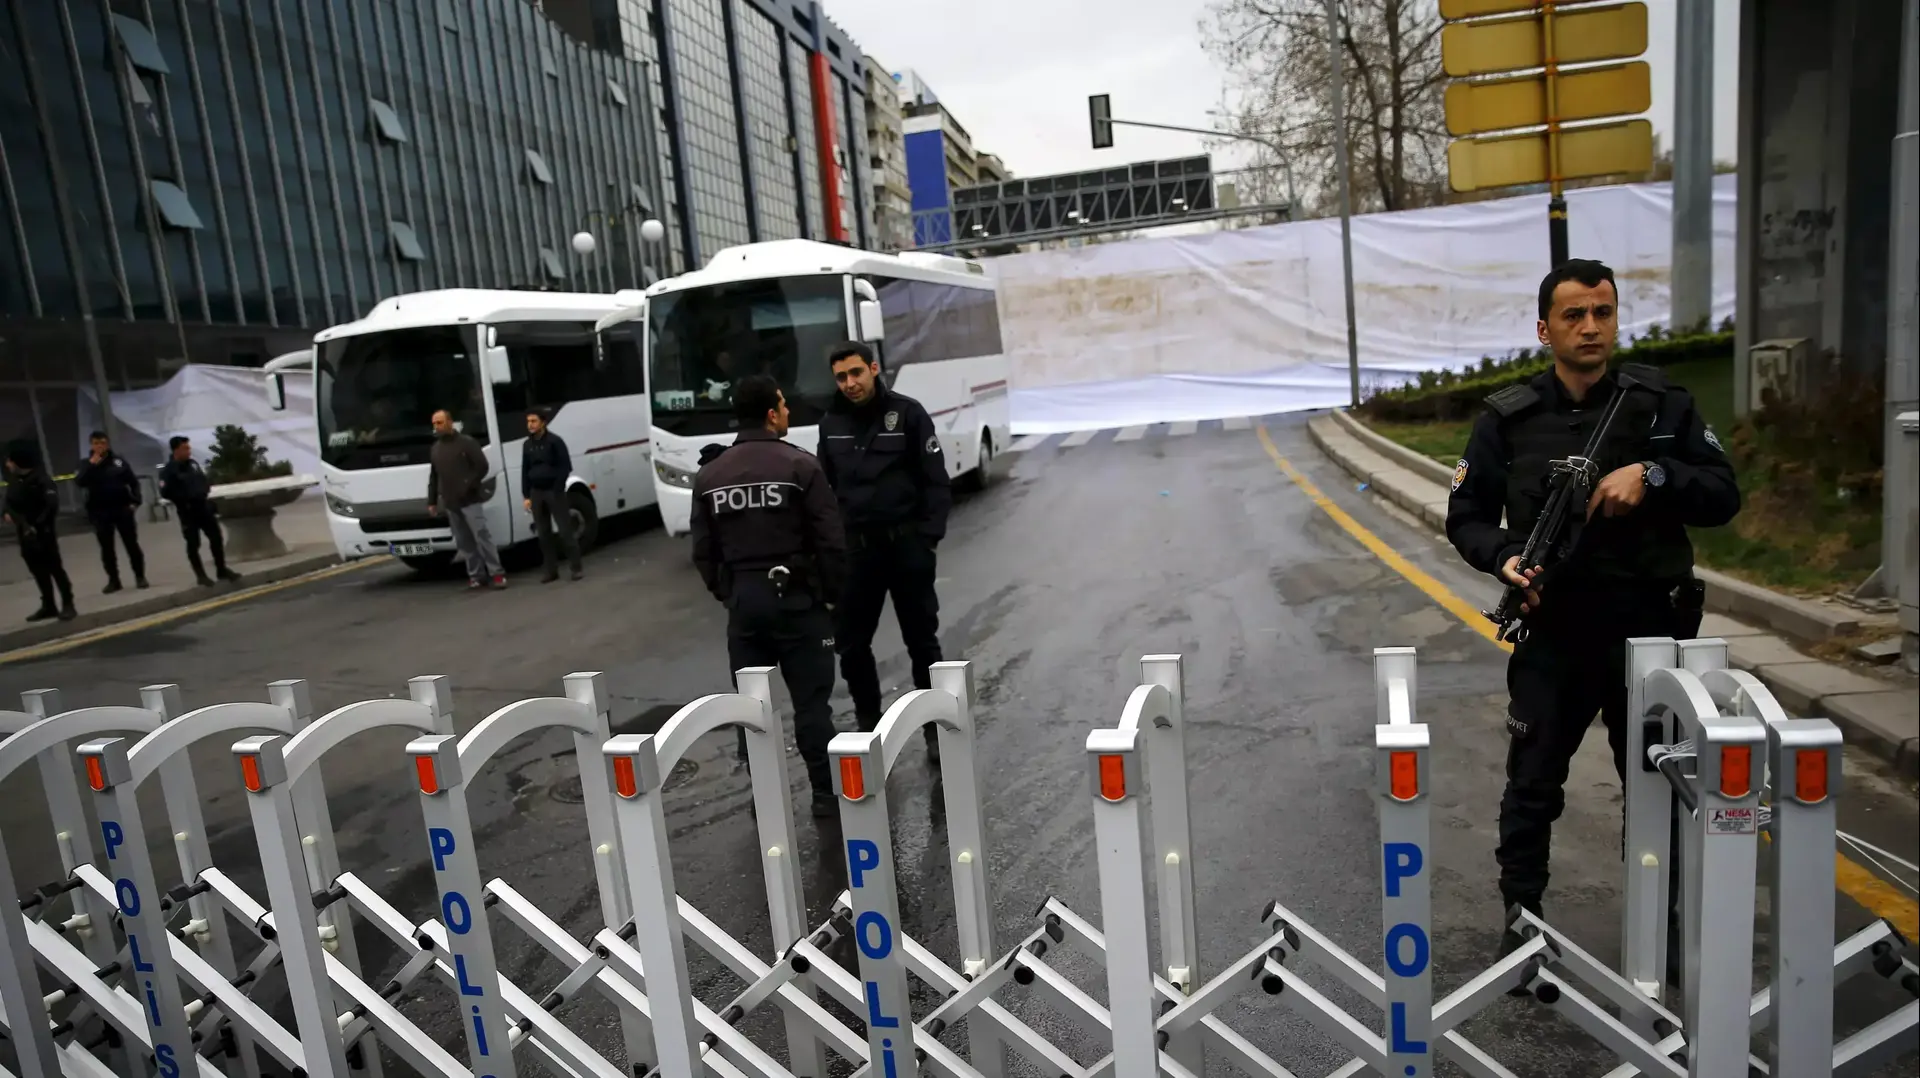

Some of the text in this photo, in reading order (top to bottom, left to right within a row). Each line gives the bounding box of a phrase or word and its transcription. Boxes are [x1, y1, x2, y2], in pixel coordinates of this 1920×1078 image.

[1725, 809, 1751, 818] NESA
[428, 828, 497, 1078] POLi
[1383, 842, 1429, 1077] POL
